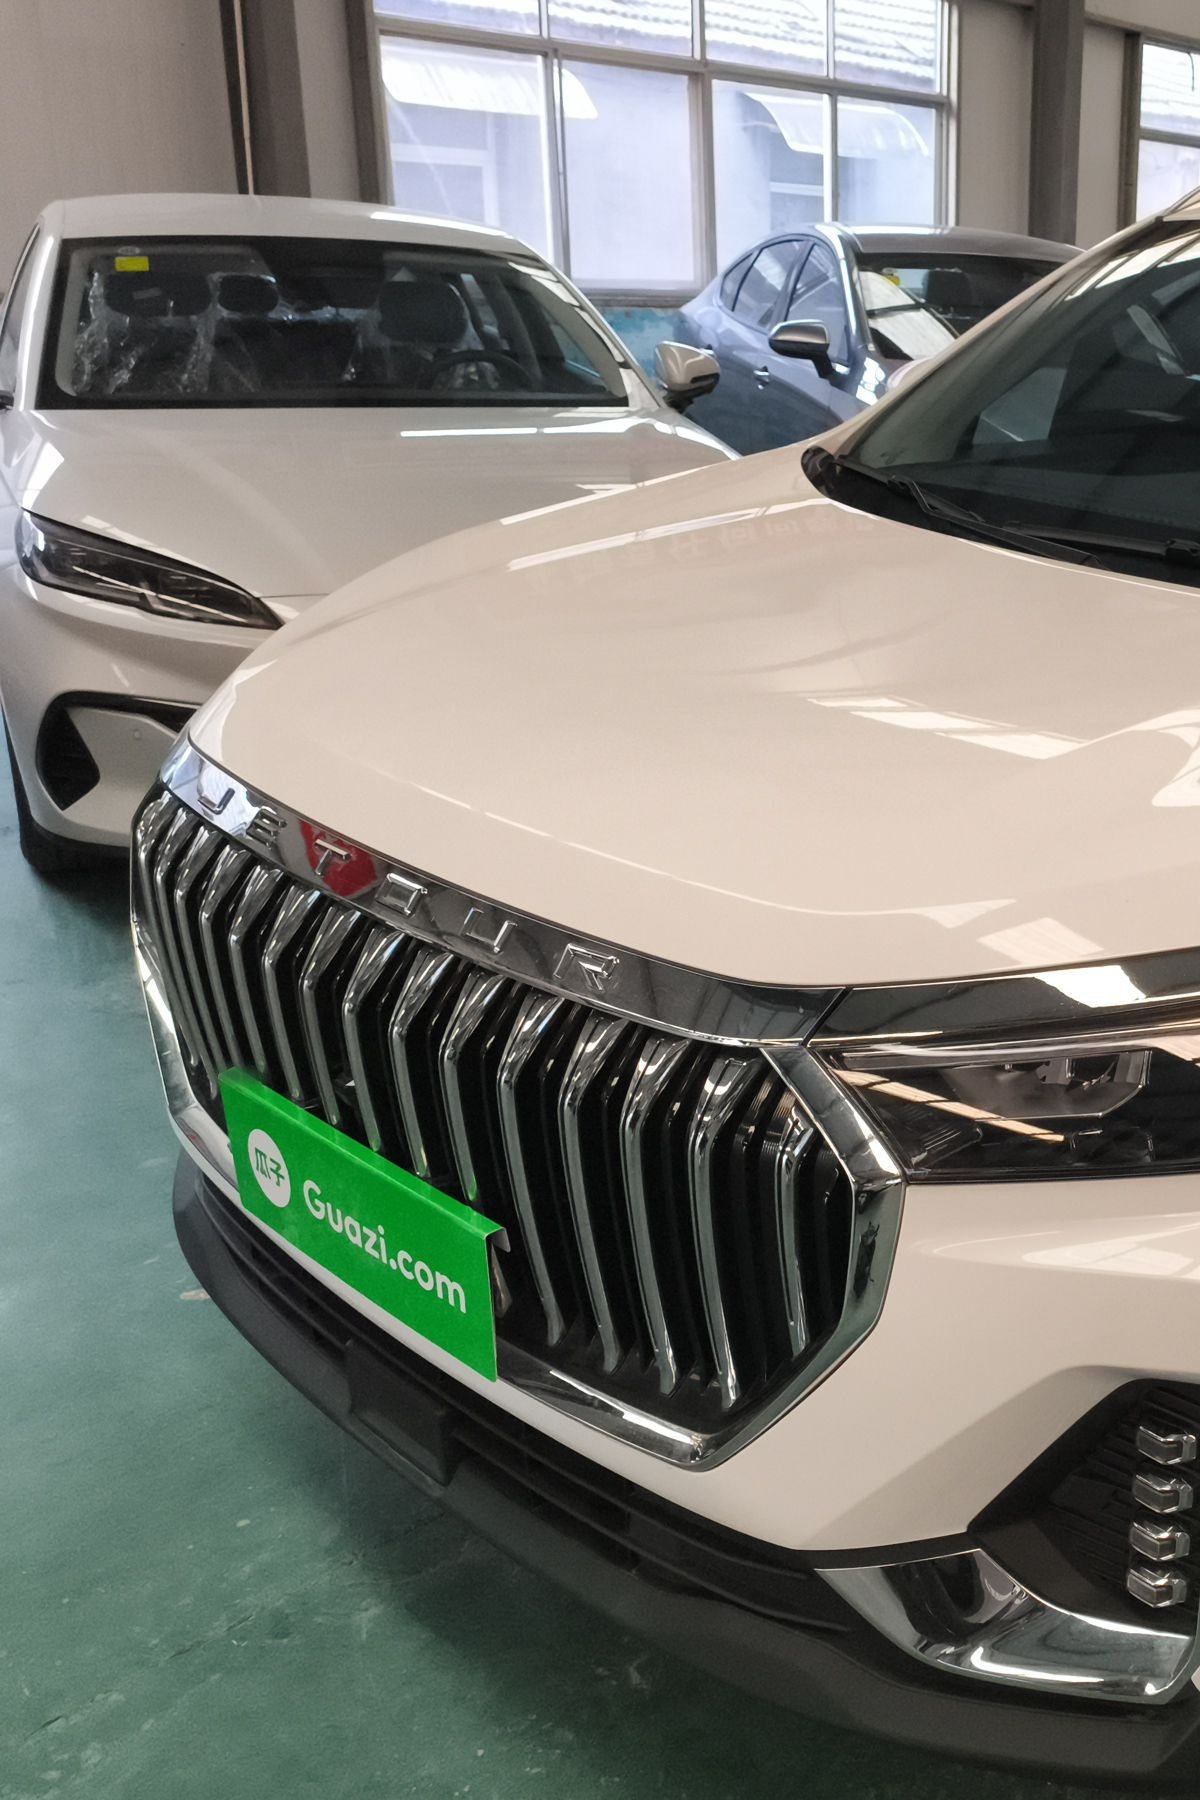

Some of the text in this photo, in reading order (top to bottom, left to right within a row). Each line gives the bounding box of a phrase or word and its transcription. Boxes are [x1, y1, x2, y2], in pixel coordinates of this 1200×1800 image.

[197, 787, 620, 991] JETOUR
[254, 1146, 466, 1314] 瓜子 Guazi.com
